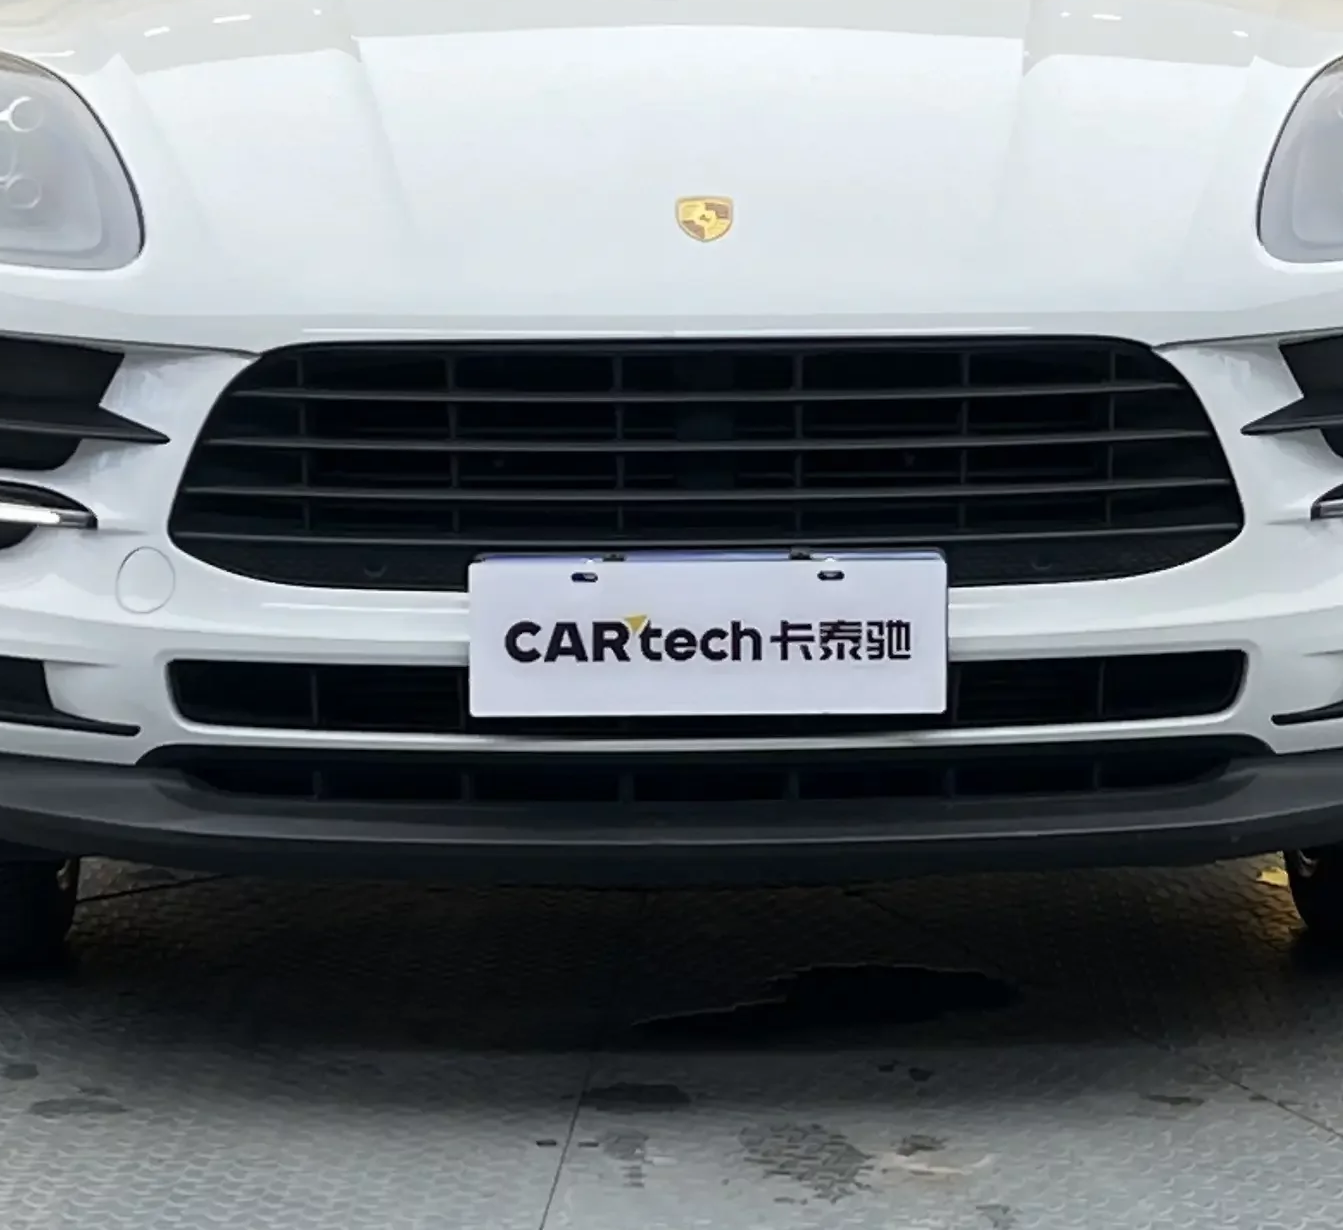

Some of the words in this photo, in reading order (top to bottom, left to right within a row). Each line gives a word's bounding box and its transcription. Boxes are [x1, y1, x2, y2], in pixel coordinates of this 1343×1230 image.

[504, 619, 763, 663] CARtech
[770, 619, 912, 661] 卡泰驰
